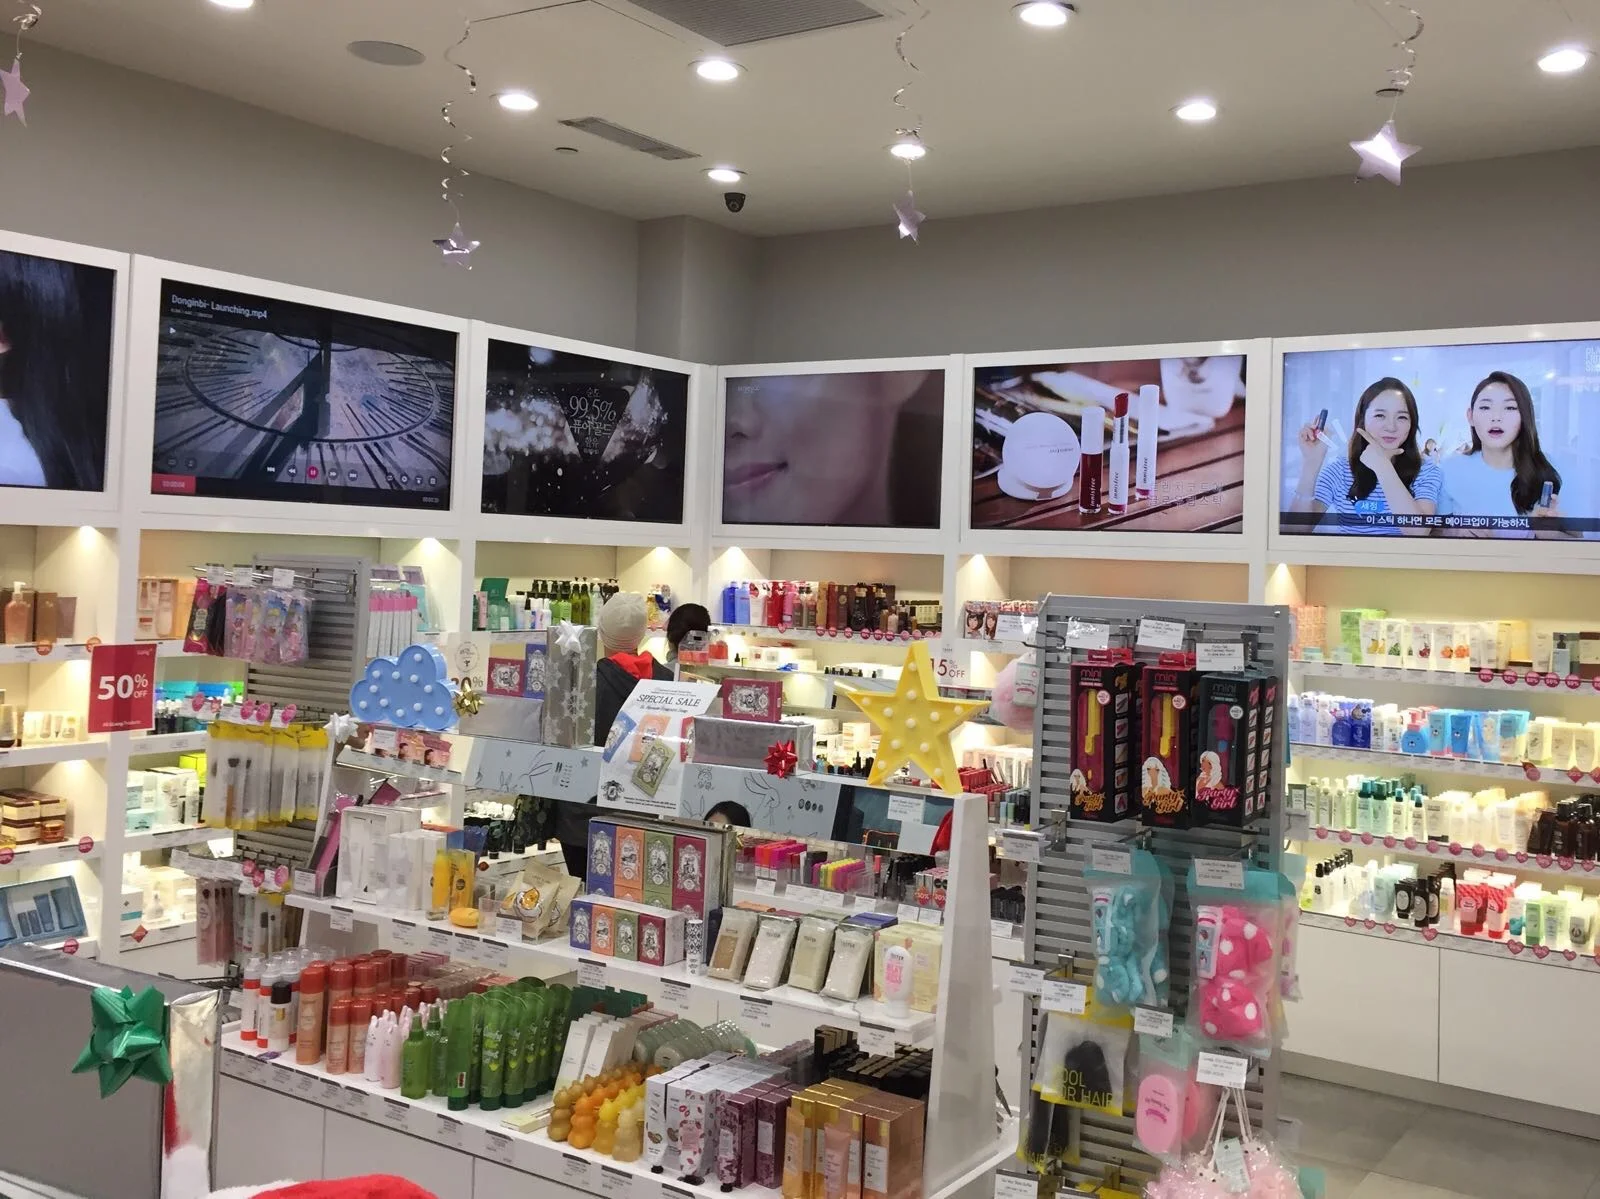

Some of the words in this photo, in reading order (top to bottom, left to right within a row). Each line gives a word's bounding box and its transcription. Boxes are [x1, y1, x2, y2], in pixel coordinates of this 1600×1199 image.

[211, 301, 268, 319] Launching.mp4
[1366, 515, 1375, 525] 이
[1377, 515, 1395, 525] 스틱
[1425, 517, 1443, 526] 모든
[1445, 517, 1489, 527] 메이크업이
[949, 669, 965, 678] OFF
[97, 674, 149, 700] 50%
[133, 689, 148, 699] OFF
[637, 694, 674, 704] SPECIAL
[675, 698, 702, 707] SALE
[1156, 800, 1183, 813] Girl
[1211, 797, 1237, 809] Girl
